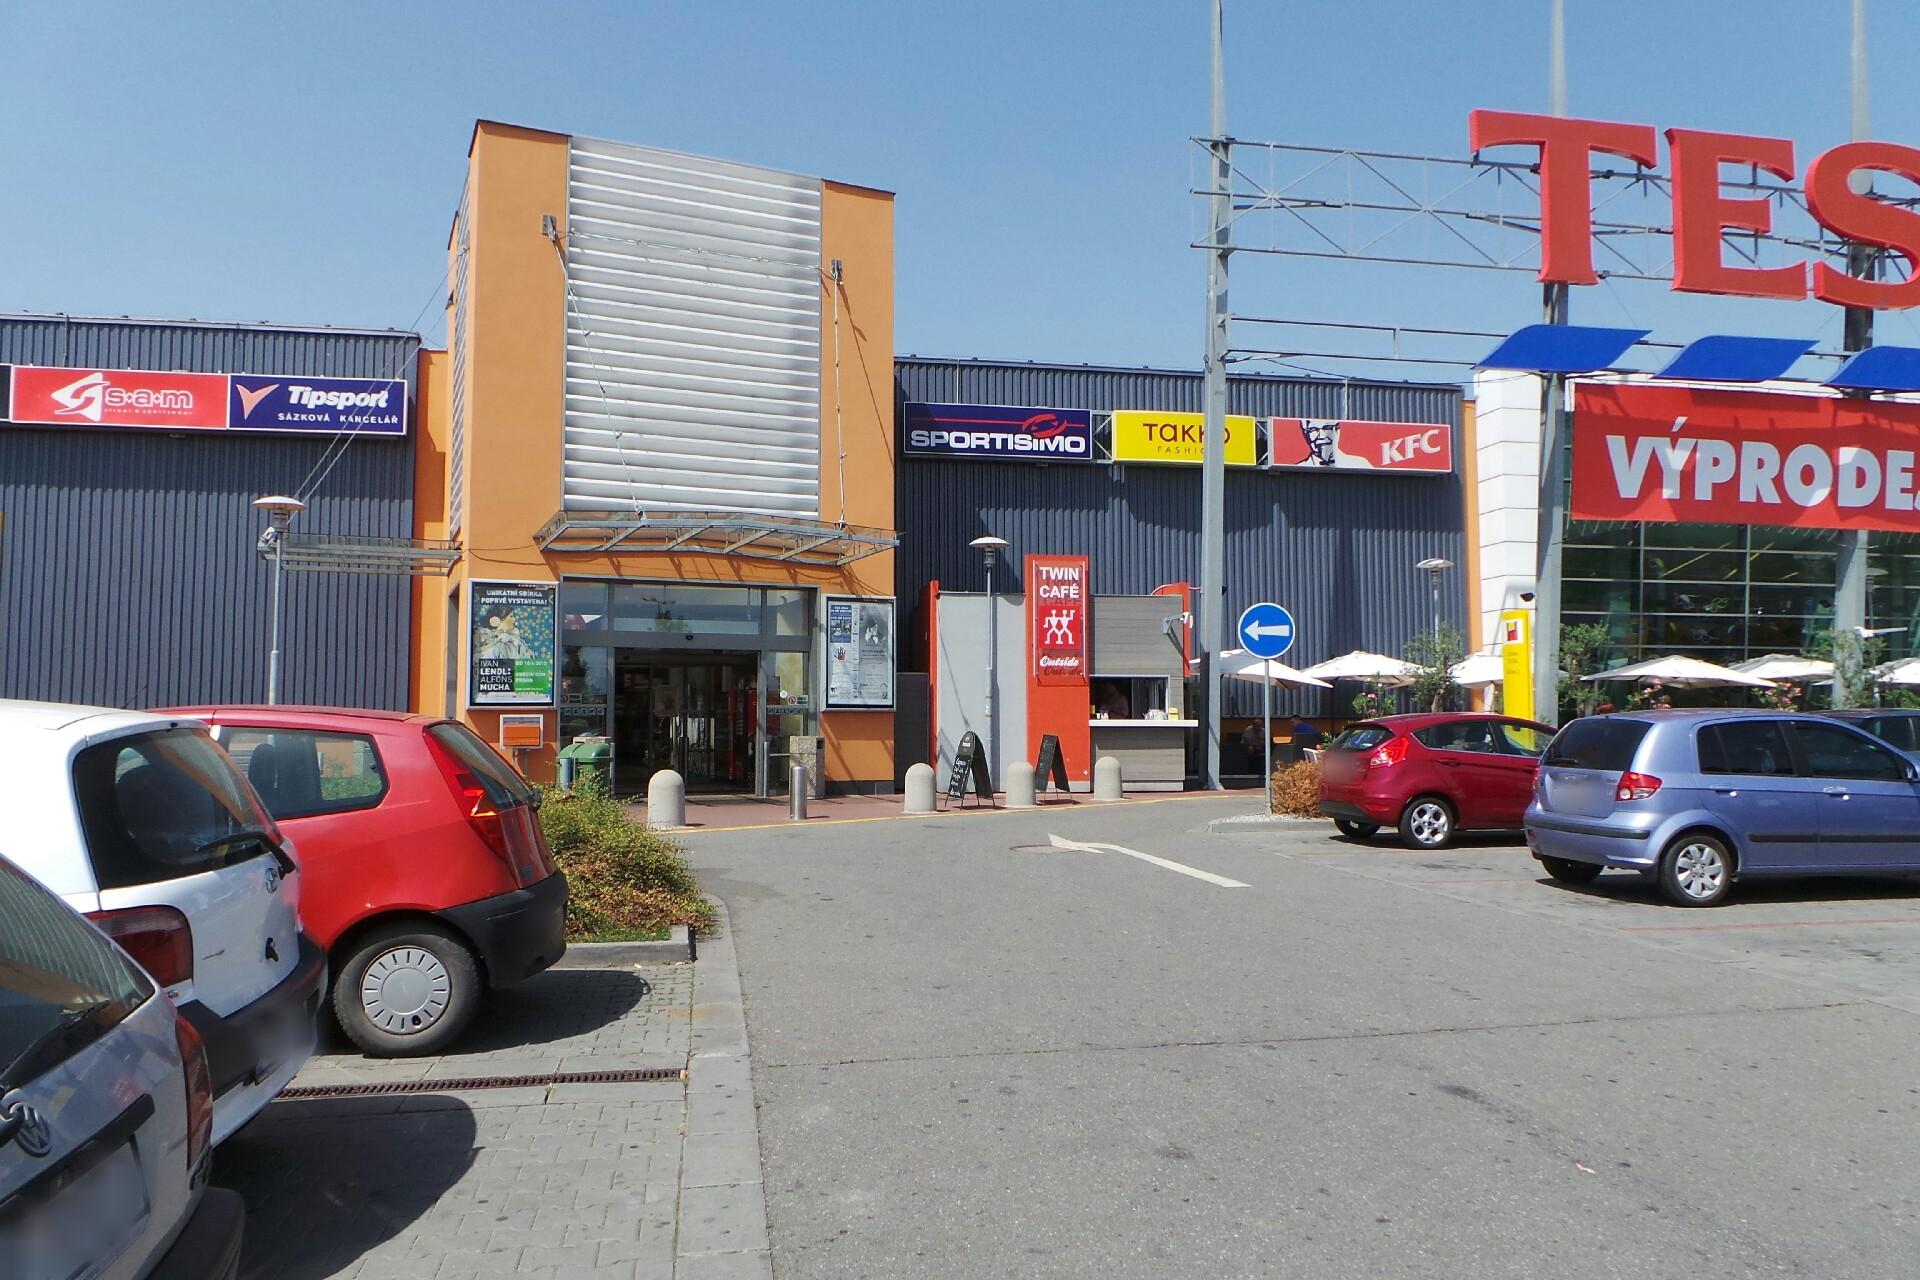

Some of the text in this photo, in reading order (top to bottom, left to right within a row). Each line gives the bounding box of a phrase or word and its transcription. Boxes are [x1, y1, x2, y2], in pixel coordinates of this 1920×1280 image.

[1469, 108, 1920, 311] TES
[288, 386, 388, 410] Tipsport
[278, 412, 398, 424] SÁZKOVÁ KANCELÁŘ
[1380, 429, 1440, 466] KFC
[1606, 416, 1920, 511] VÝPRODE
[1040, 567, 1079, 580] TWIN
[1040, 583, 1079, 598] CAFÉ
[481, 596, 507, 604] POPRVÉ
[1040, 656, 1079, 667] Outside
[480, 668, 511, 676] LENDL:
